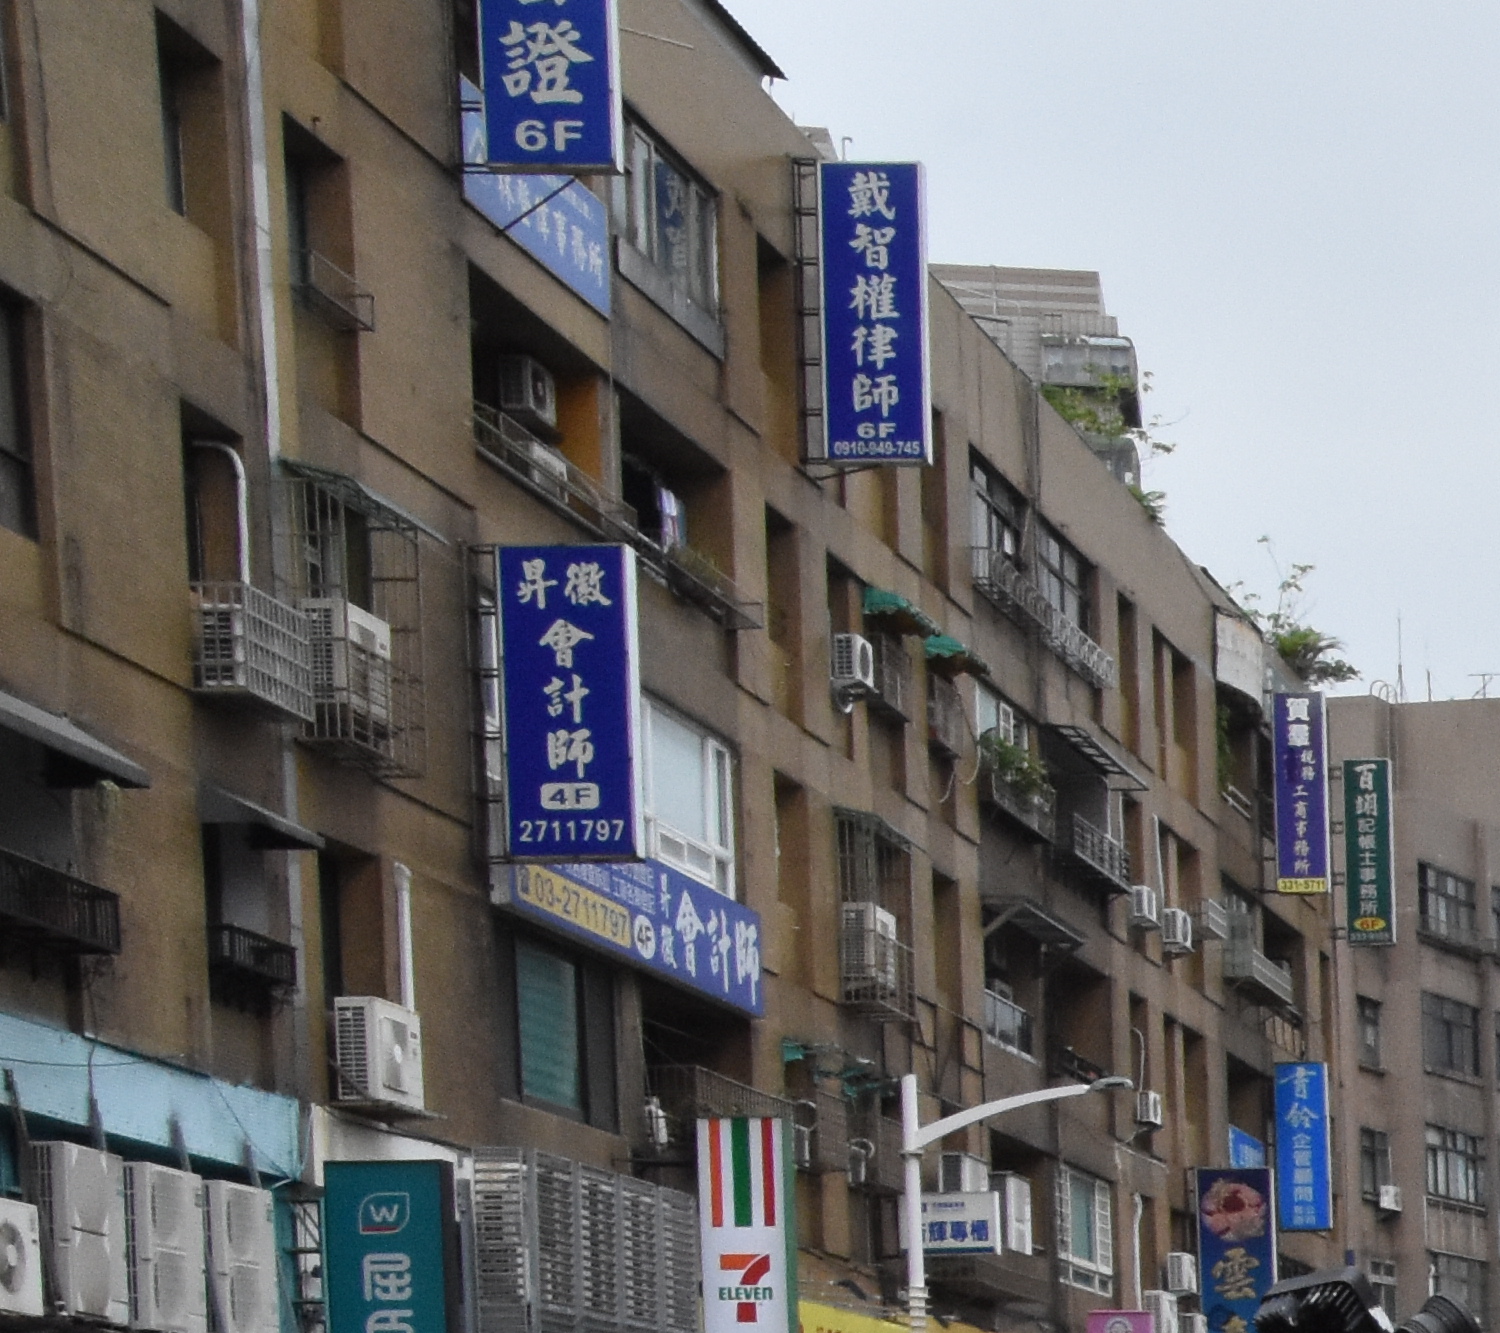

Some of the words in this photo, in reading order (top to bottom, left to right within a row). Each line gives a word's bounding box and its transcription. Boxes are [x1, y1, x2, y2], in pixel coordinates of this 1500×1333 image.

[499, 0, 595, 104] 證
[515, 120, 584, 151] 6F
[848, 172, 900, 418] 戴智權律師
[857, 422, 896, 438] 6F
[539, 618, 595, 779] 會計師
[519, 818, 624, 842] 2711797
[550, 787, 592, 805] 4F
[535, 872, 628, 941] 03-2711797
[675, 890, 759, 1006] 會計師
